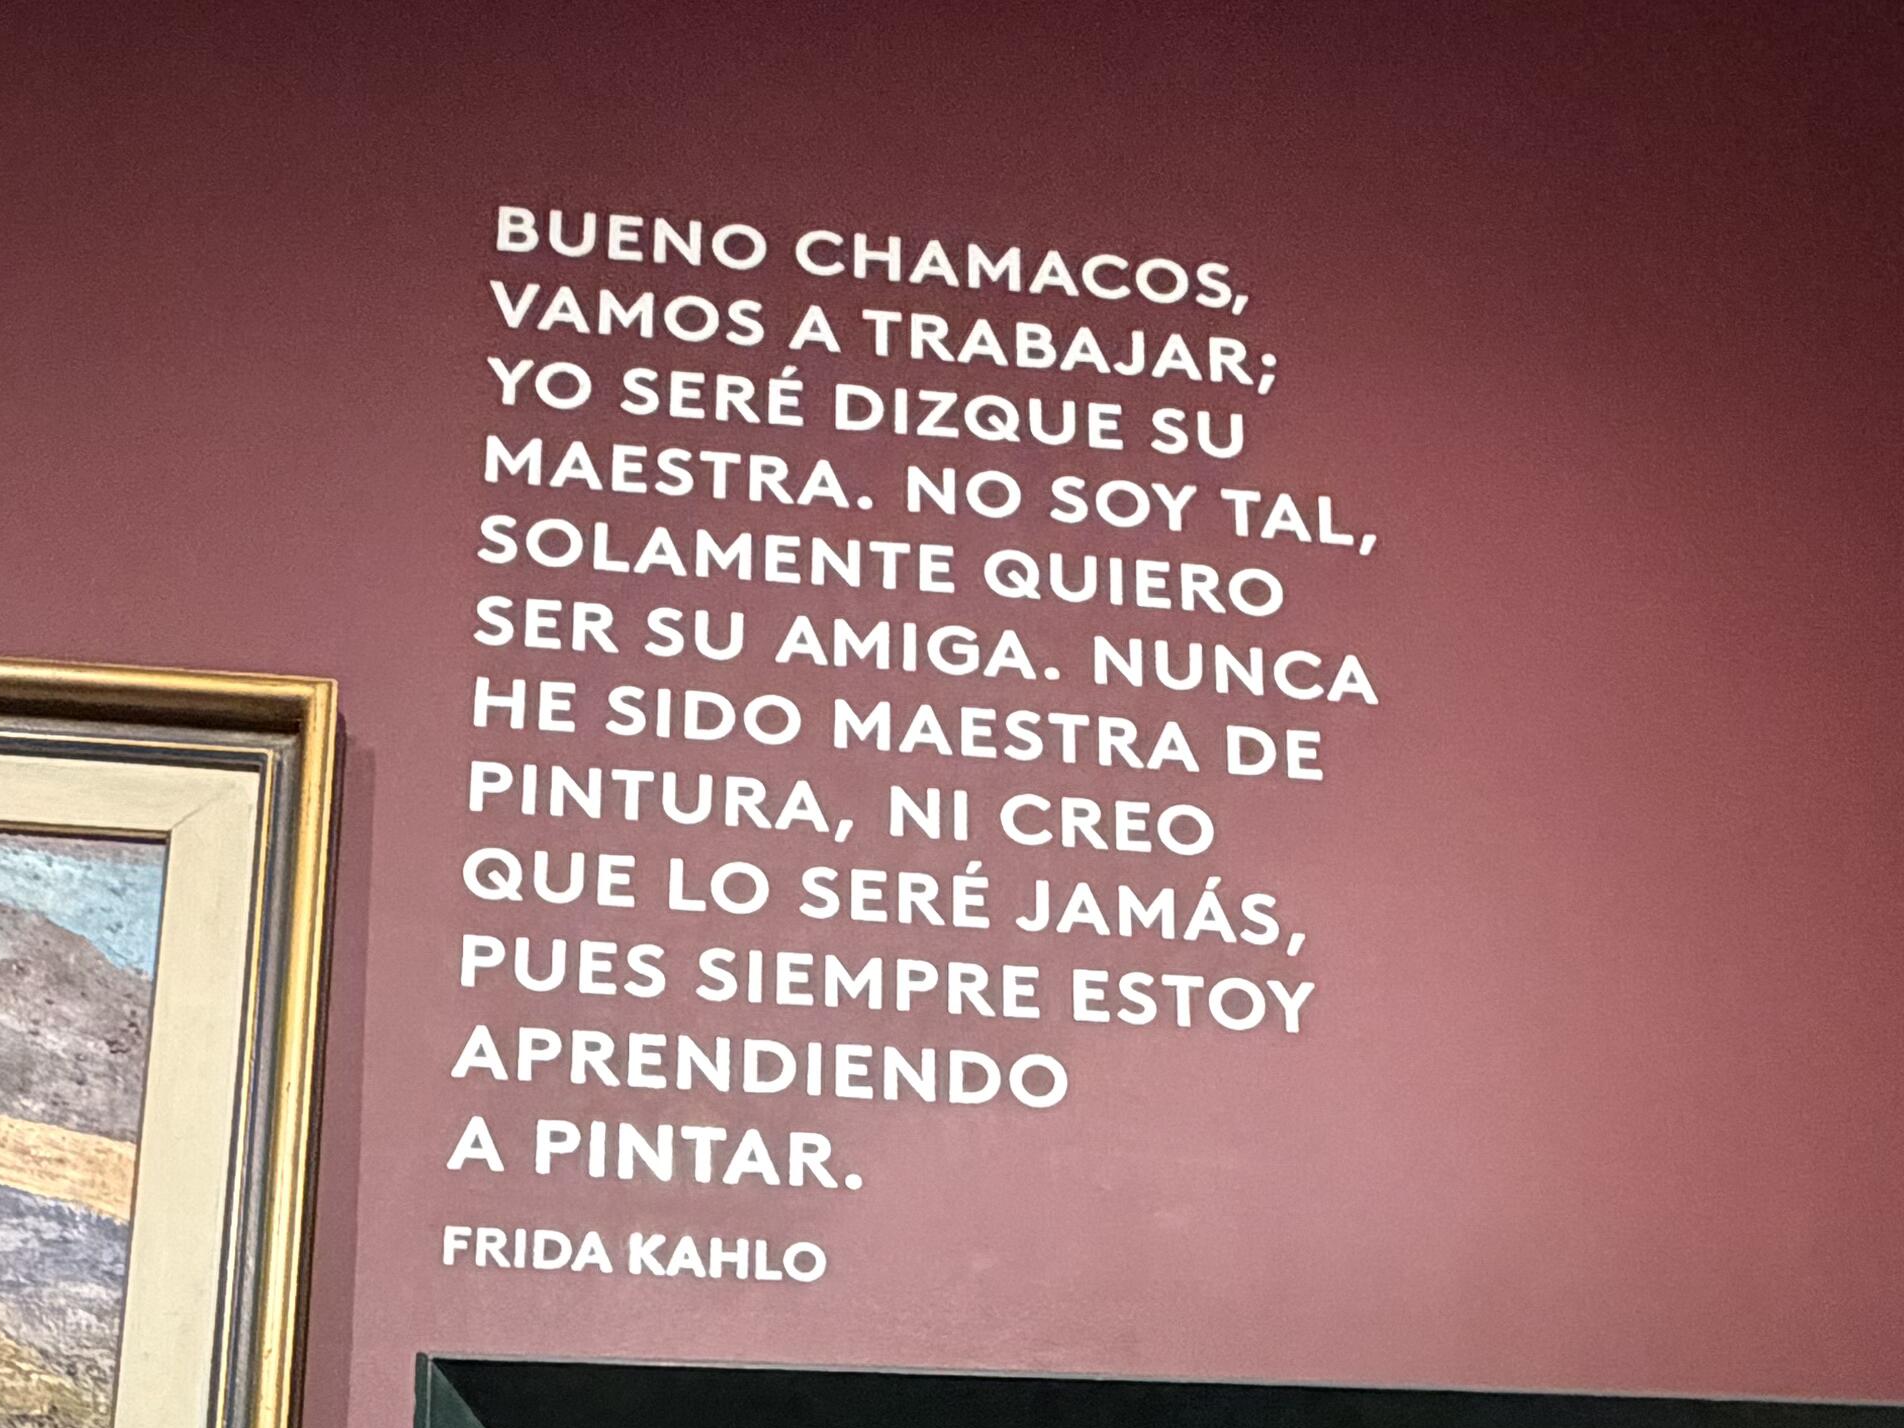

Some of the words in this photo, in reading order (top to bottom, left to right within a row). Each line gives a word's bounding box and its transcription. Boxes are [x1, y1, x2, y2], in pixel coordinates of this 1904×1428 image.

[497, 206, 767, 270] BUENO
[795, 230, 1249, 315] CHAMACOS,
[490, 280, 765, 346] VAMOS
[789, 305, 841, 353] A
[862, 309, 1277, 395] TRABAJAR;
[487, 357, 592, 410] YO
[620, 365, 804, 427] SERÉ
[835, 383, 1124, 450] DIZQUE
[1150, 407, 1244, 459] SU
[484, 435, 873, 510] MAESTRA.
[907, 465, 1022, 519] NO
[1050, 475, 1197, 532] SOY
[1220, 488, 1377, 556] TAL,
[477, 514, 955, 594] SOLAMENTE
[983, 549, 1284, 617] QUIERO
[473, 595, 619, 654] SER
[644, 607, 745, 661] SU
[775, 615, 1060, 680] AMIGA.
[1094, 635, 1379, 705] NUNCA
[473, 676, 576, 733] HE
[605, 685, 802, 746] SIDO
[833, 698, 1200, 773] MAESTRA
[1226, 724, 1324, 781] DE
[469, 760, 854, 843] PINTURA,
[889, 785, 968, 841] NI
[999, 793, 1215, 856] CREO
[462, 847, 636, 908] QUE
[668, 857, 770, 915] LO
[799, 860, 990, 929] SERÉ
[1015, 876, 1306, 957] JAMÁS,
[460, 934, 666, 998] PUES
[695, 947, 1041, 1019] SIEMPRE
[1072, 968, 1315, 1034] ESTOY
[450, 1024, 1068, 1109] APRENDIENDO
[446, 1115, 505, 1172] A
[535, 1118, 863, 1191] PINTAR.
[442, 1225, 614, 1274] FRIDA
[628, 1231, 827, 1283] KAHLO
